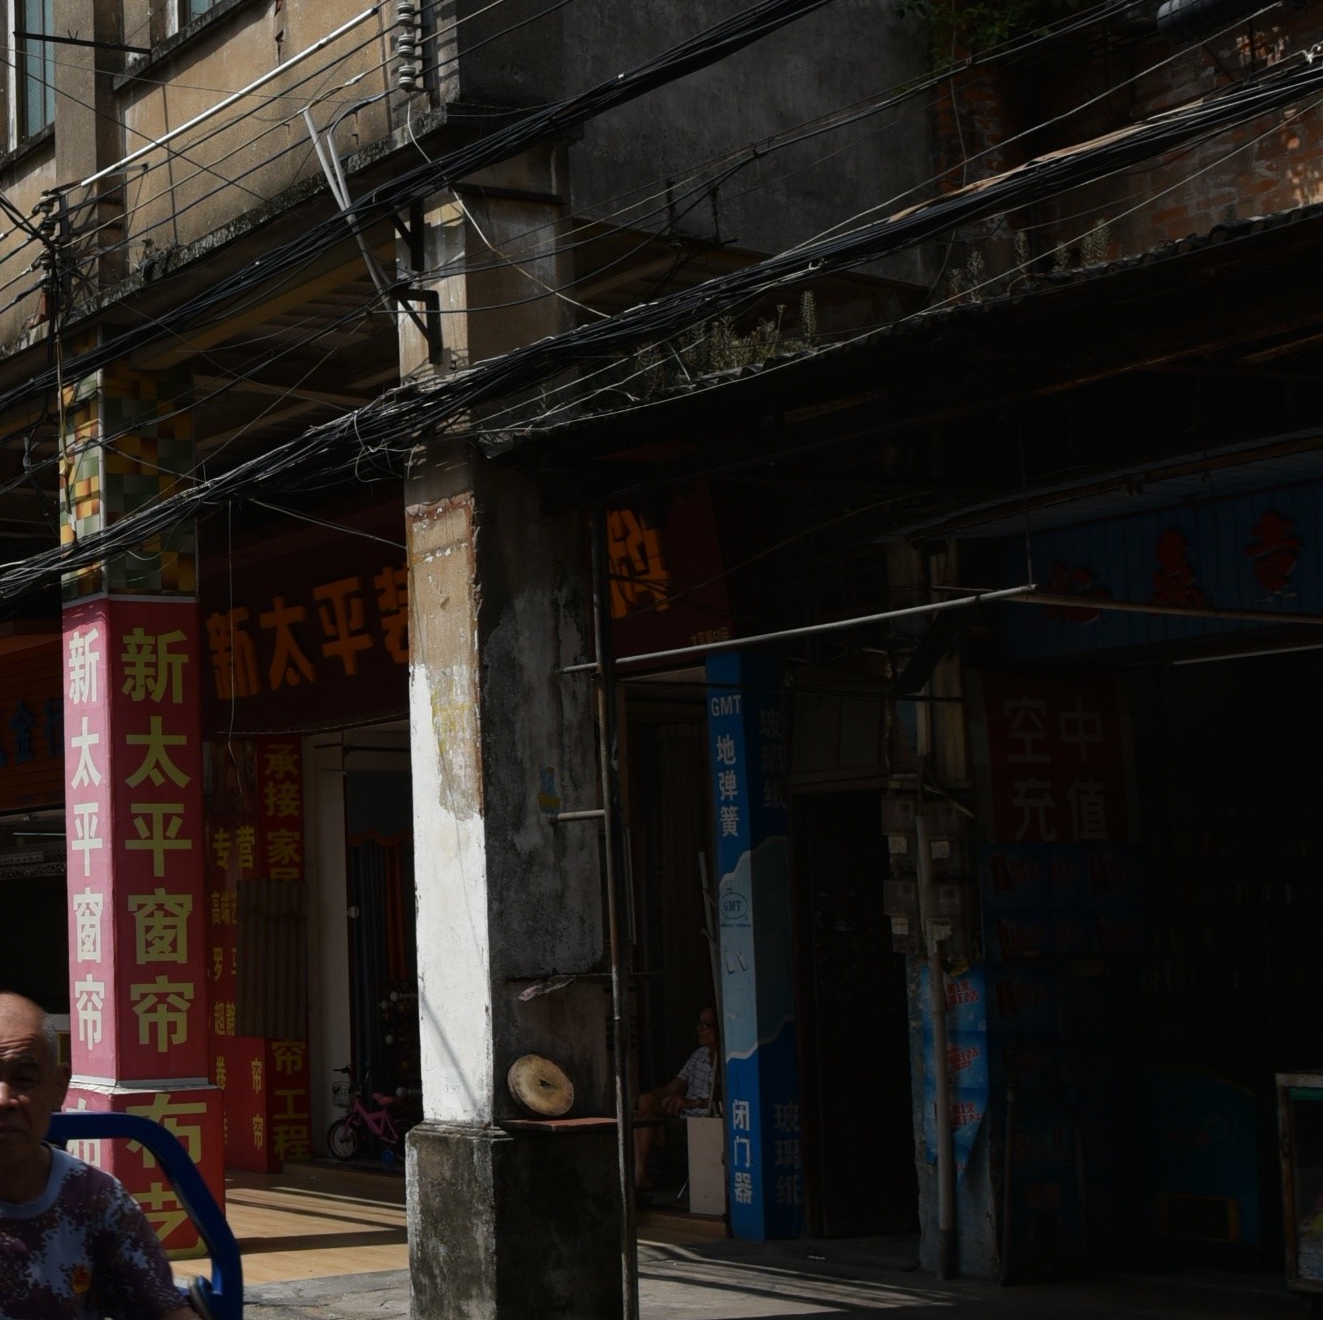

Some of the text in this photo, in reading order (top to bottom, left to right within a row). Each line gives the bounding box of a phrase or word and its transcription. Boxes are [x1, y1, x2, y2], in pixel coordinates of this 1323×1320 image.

[710, 694, 742, 717] GMT
[1003, 695, 1103, 764] 空中
[716, 733, 739, 838] 地弹簧
[1012, 776, 1110, 843] 充值
[68, 628, 103, 1050] 新太平窗帘
[121, 627, 196, 1053] 新太平窗帘
[731, 1099, 753, 1205] 闭门器
